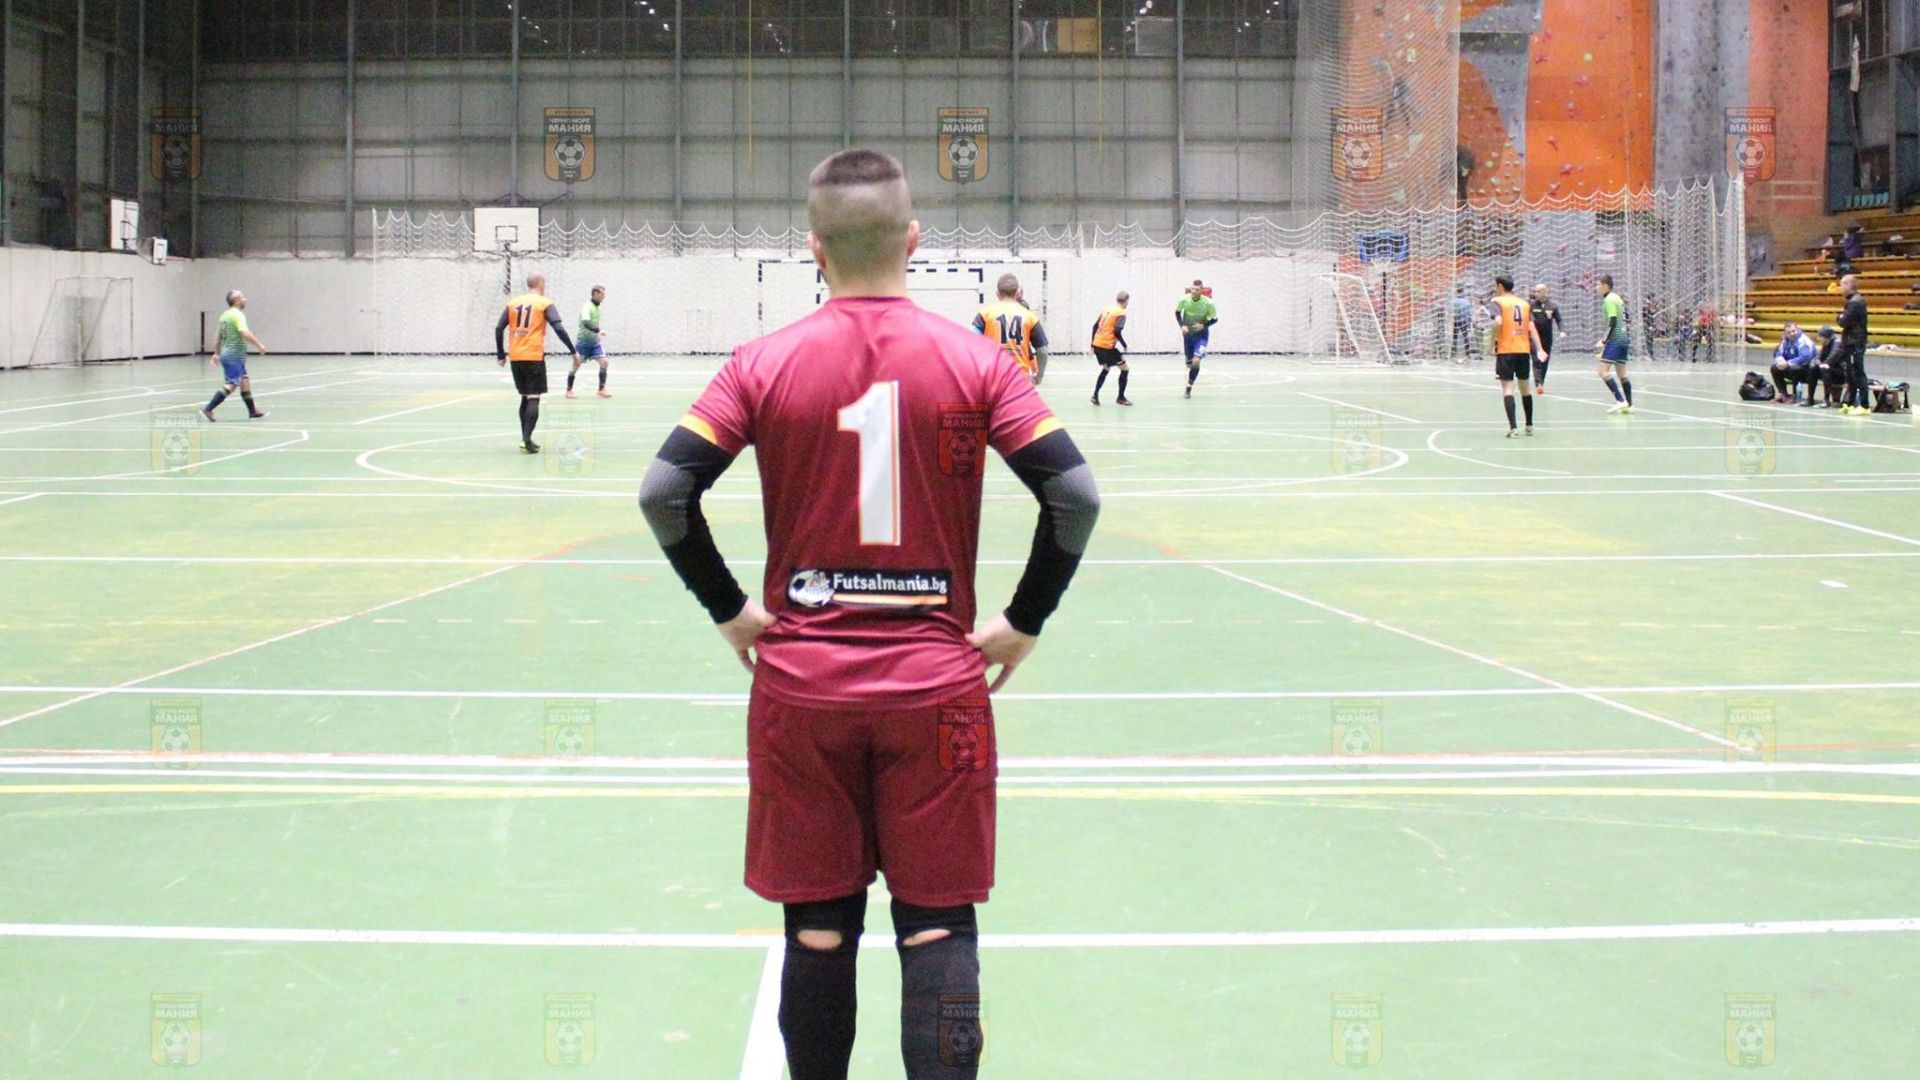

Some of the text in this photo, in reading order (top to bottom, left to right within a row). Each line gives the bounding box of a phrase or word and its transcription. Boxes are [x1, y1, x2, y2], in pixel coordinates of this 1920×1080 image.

[515, 304, 532, 328] 11
[1514, 304, 1523, 326] 4
[996, 314, 1023, 345] 14
[837, 380, 901, 546] 1
[833, 573, 947, 594] Futsalmania.bg
